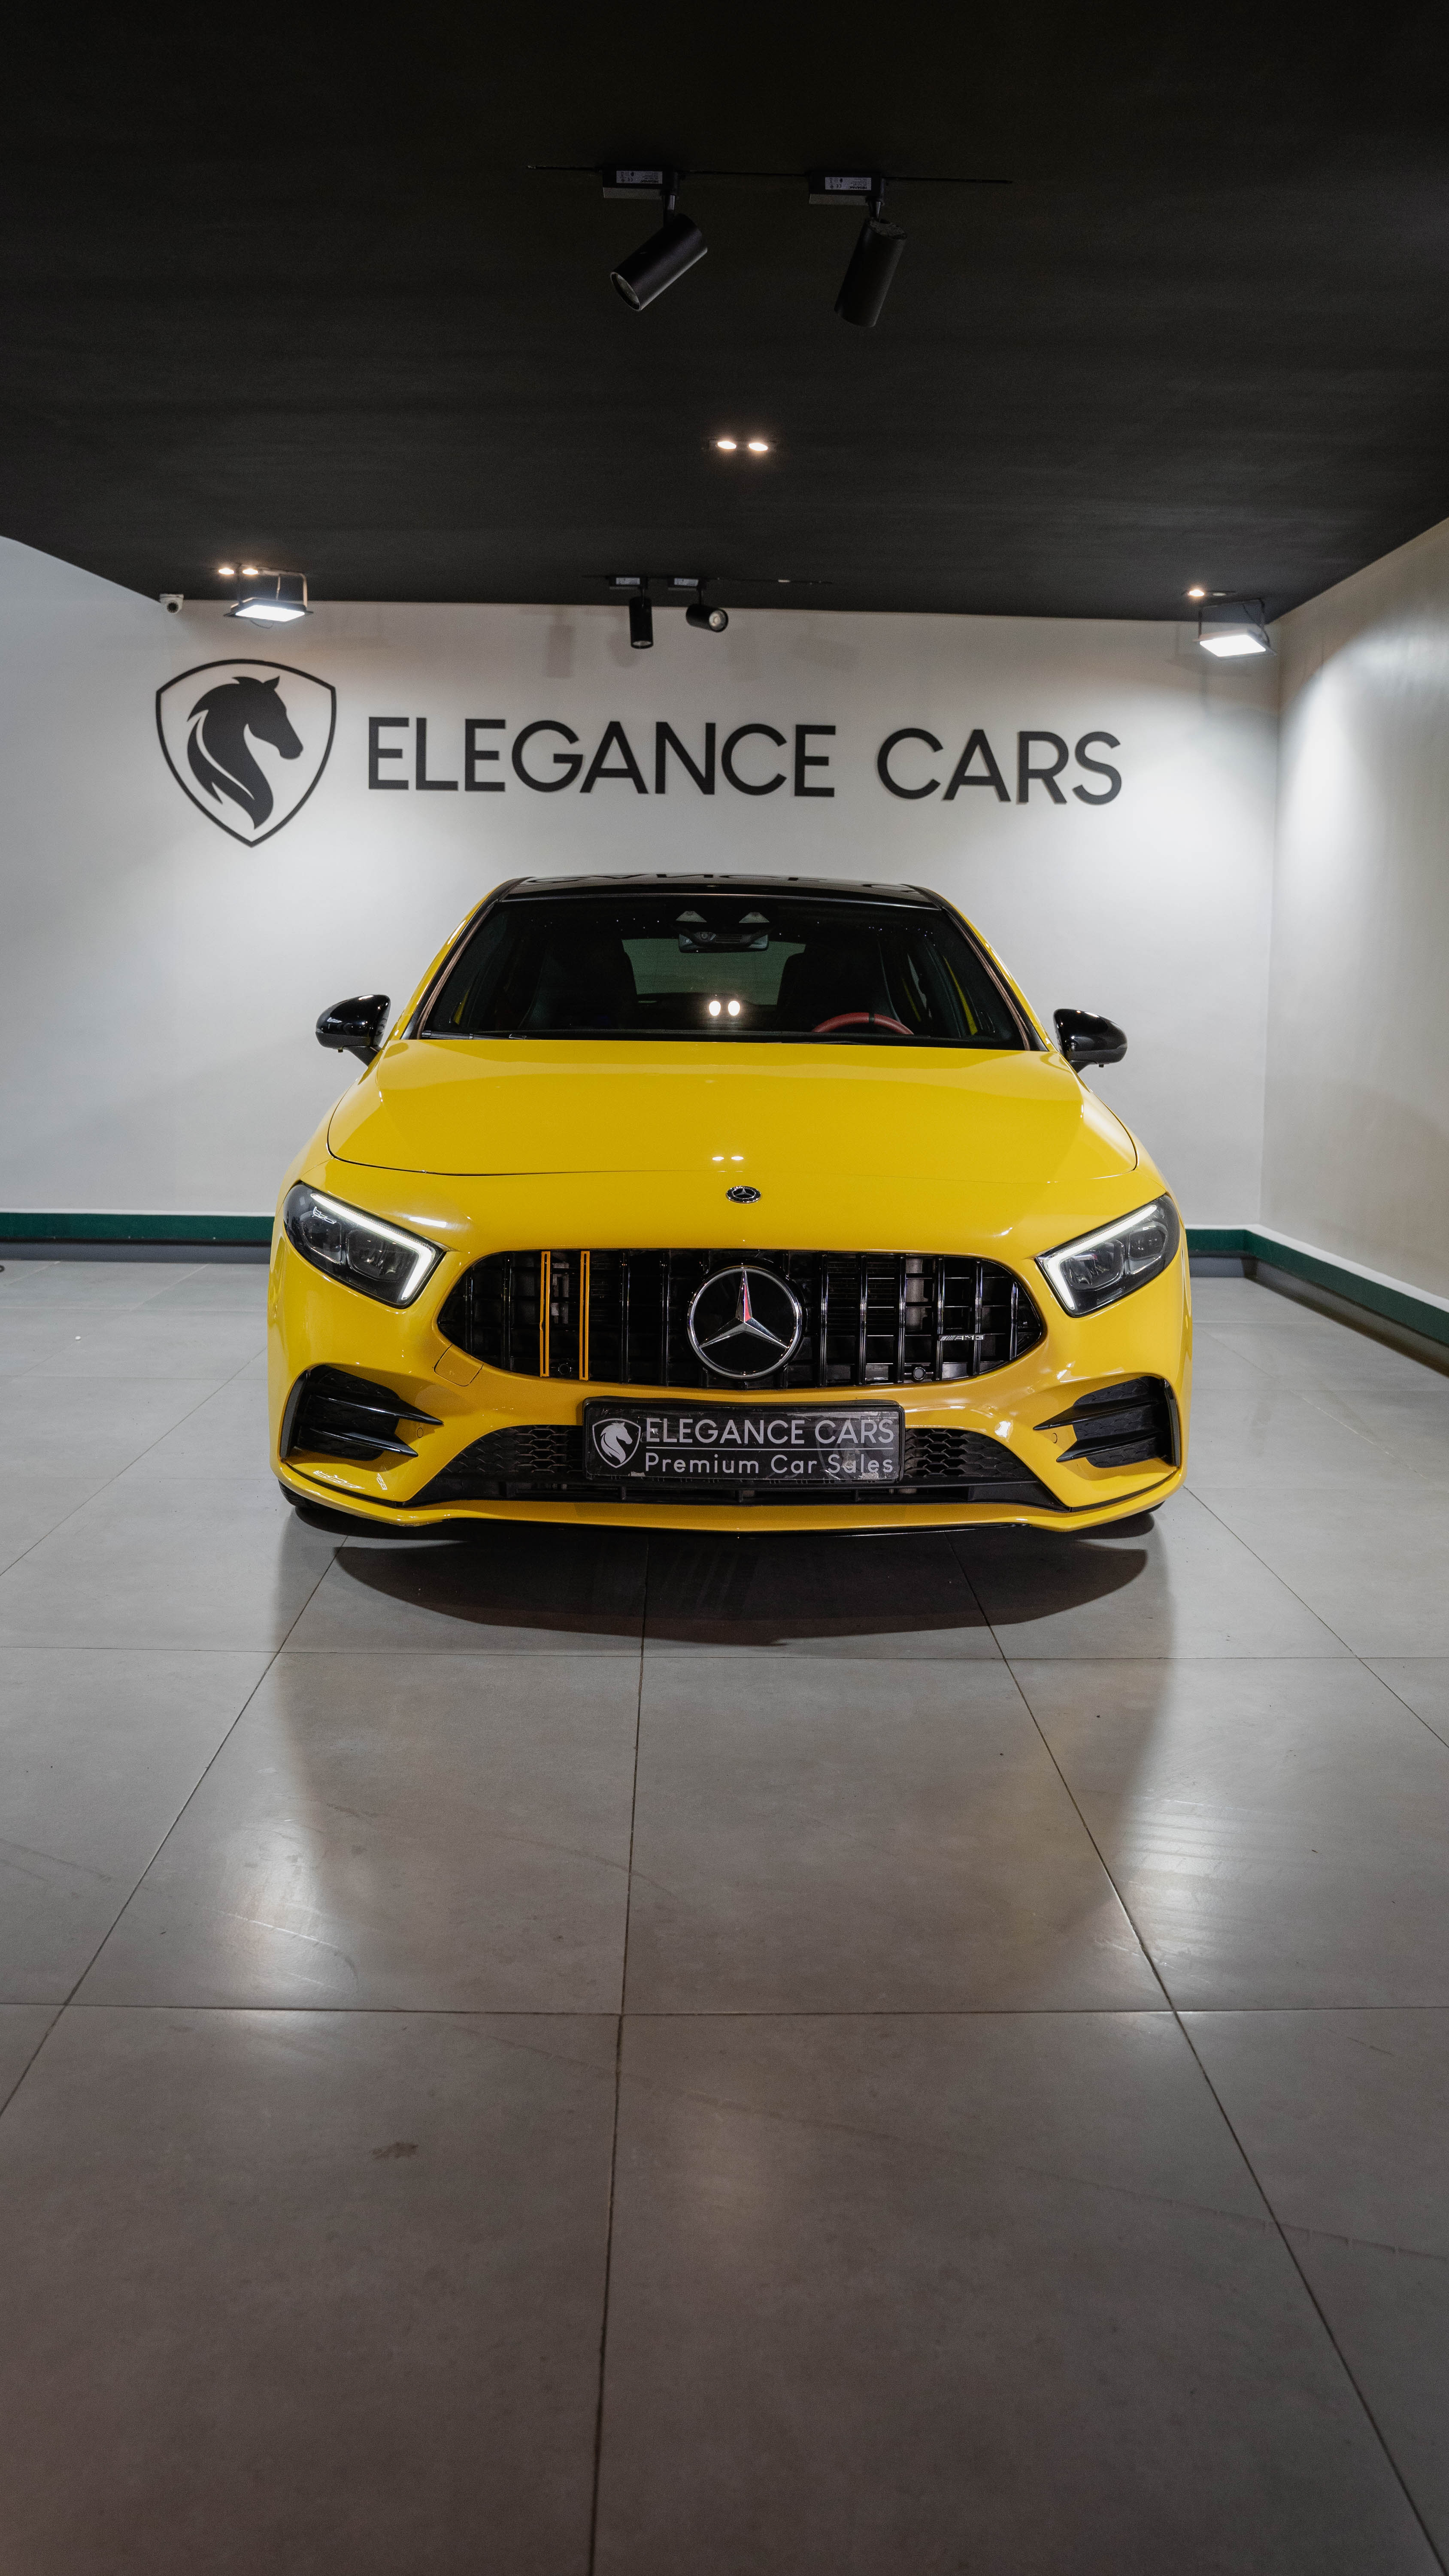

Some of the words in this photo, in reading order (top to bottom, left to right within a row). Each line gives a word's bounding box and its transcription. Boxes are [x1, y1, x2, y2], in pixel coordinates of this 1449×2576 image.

[368, 716, 837, 798] ELEGANCE
[876, 727, 1122, 805] CARS
[646, 1418, 805, 1444] ELEGANCE
[814, 1419, 894, 1444] CARS
[645, 1452, 759, 1474] Premium
[770, 1454, 818, 1474] Car
[827, 1454, 894, 1474] Sales
